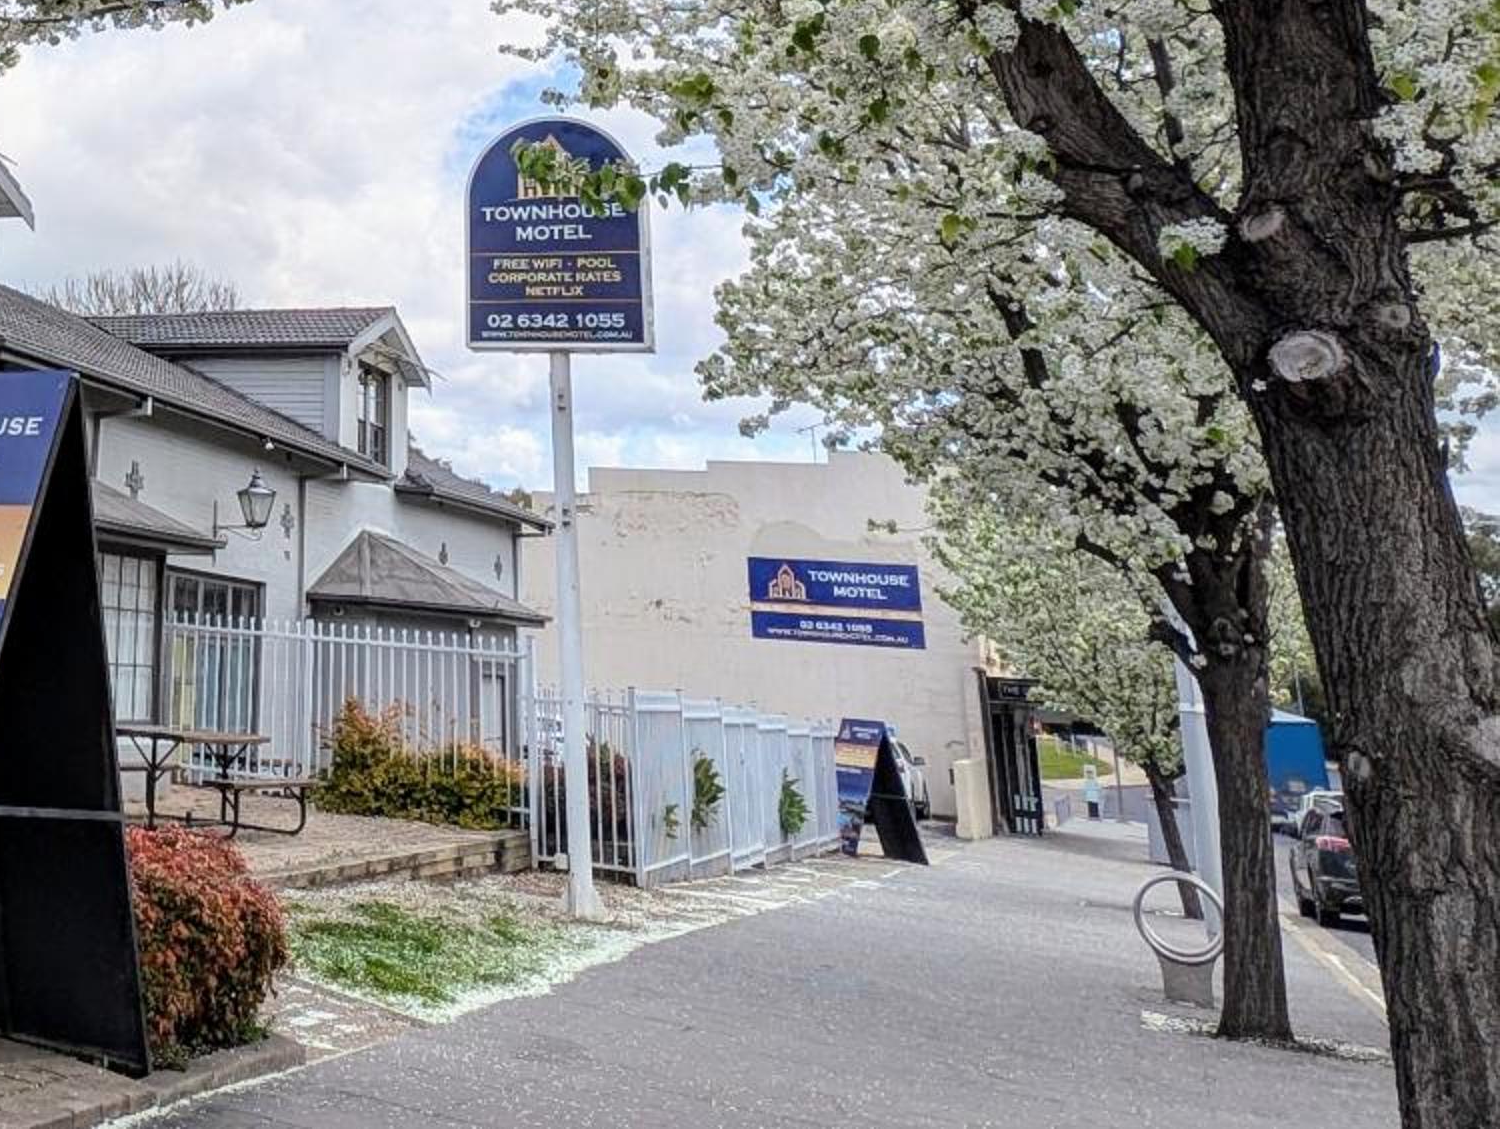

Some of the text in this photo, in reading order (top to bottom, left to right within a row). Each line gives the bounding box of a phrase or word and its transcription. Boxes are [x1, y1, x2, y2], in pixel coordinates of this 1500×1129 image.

[481, 202, 626, 221] TOWNHOUSE
[515, 224, 592, 241] MOTEL
[493, 257, 616, 270] FREE WIFI POOL
[488, 271, 621, 283] CORPORATE RATES
[525, 285, 584, 296] NETFLIX
[487, 313, 625, 328] 02 6342 1055
[807, 569, 911, 587] TOWNHOUSE
[833, 586, 887, 600] MOTEL
